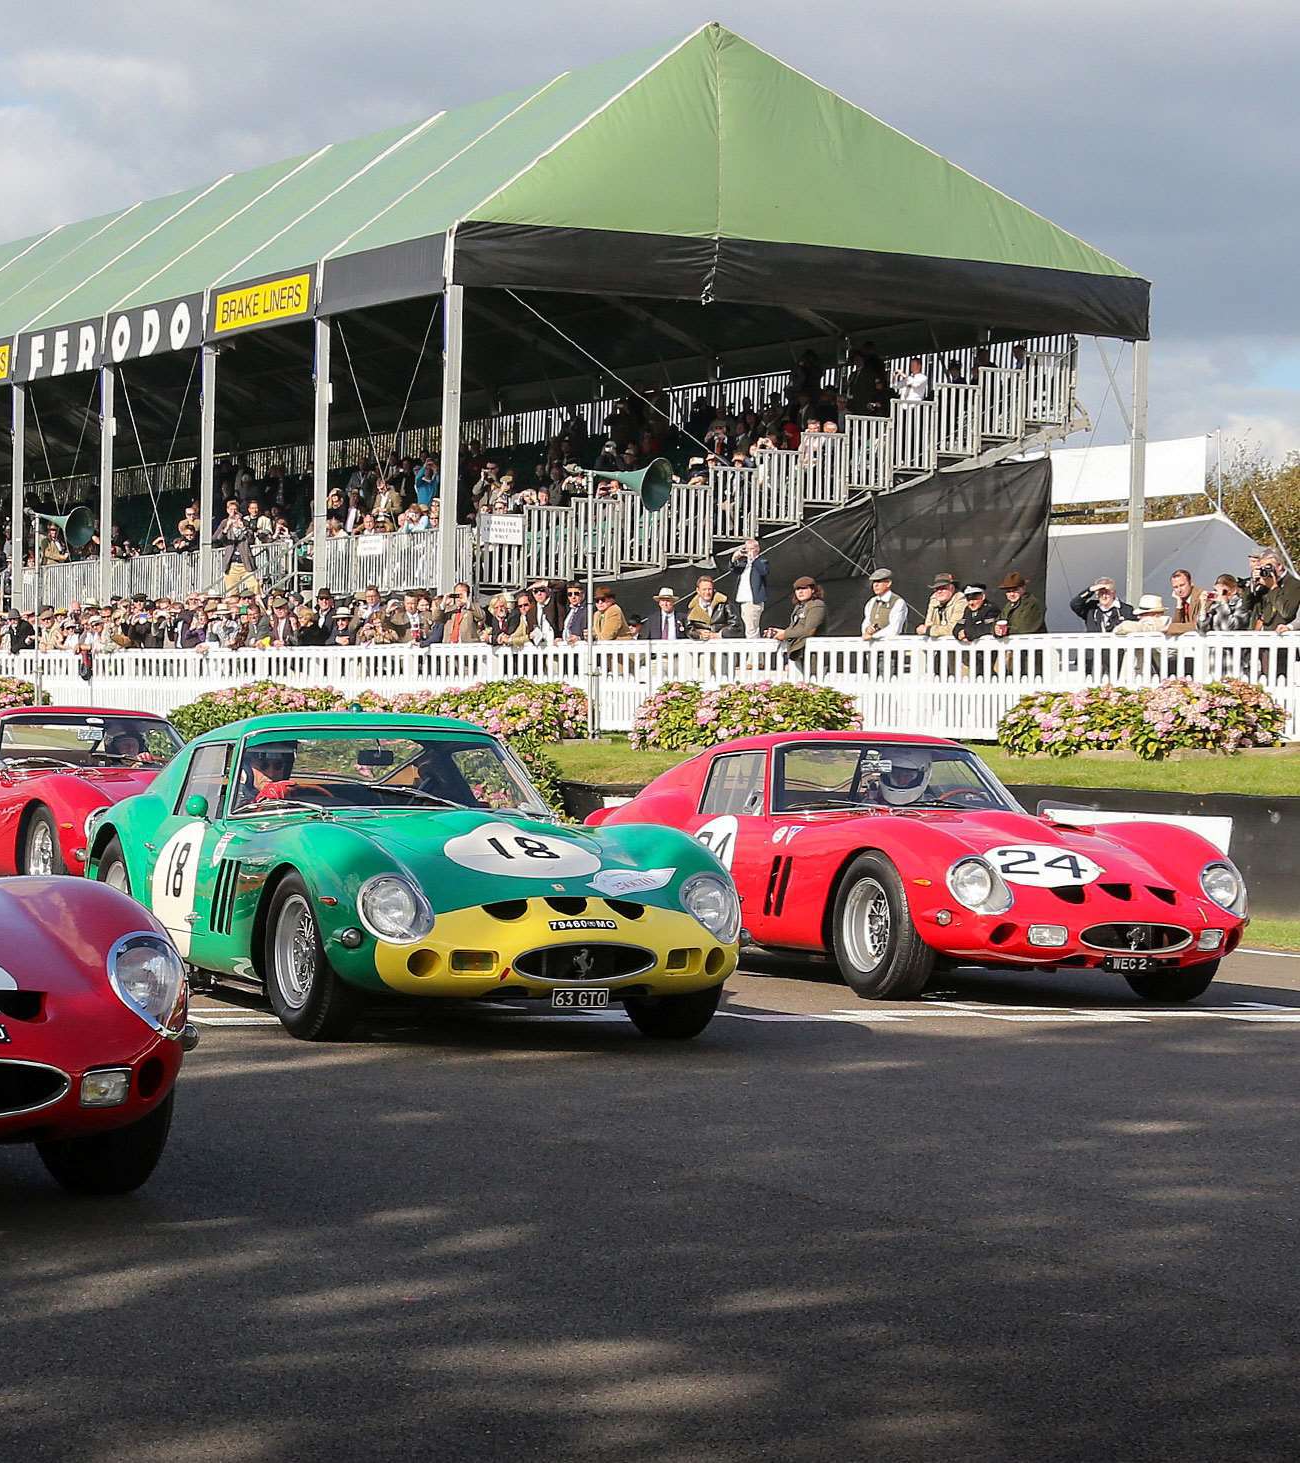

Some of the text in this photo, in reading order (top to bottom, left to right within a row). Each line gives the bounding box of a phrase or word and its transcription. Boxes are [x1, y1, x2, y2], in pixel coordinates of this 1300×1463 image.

[221, 283, 302, 324] BRAKE LINERS
[27, 302, 191, 382] FERODO
[487, 836, 561, 859] 18
[165, 841, 192, 898] 18
[997, 849, 1088, 879] 24
[549, 920, 615, 930] 79460 MO
[1112, 958, 1148, 970] WEC 2
[555, 991, 606, 1006] 63 GTO
